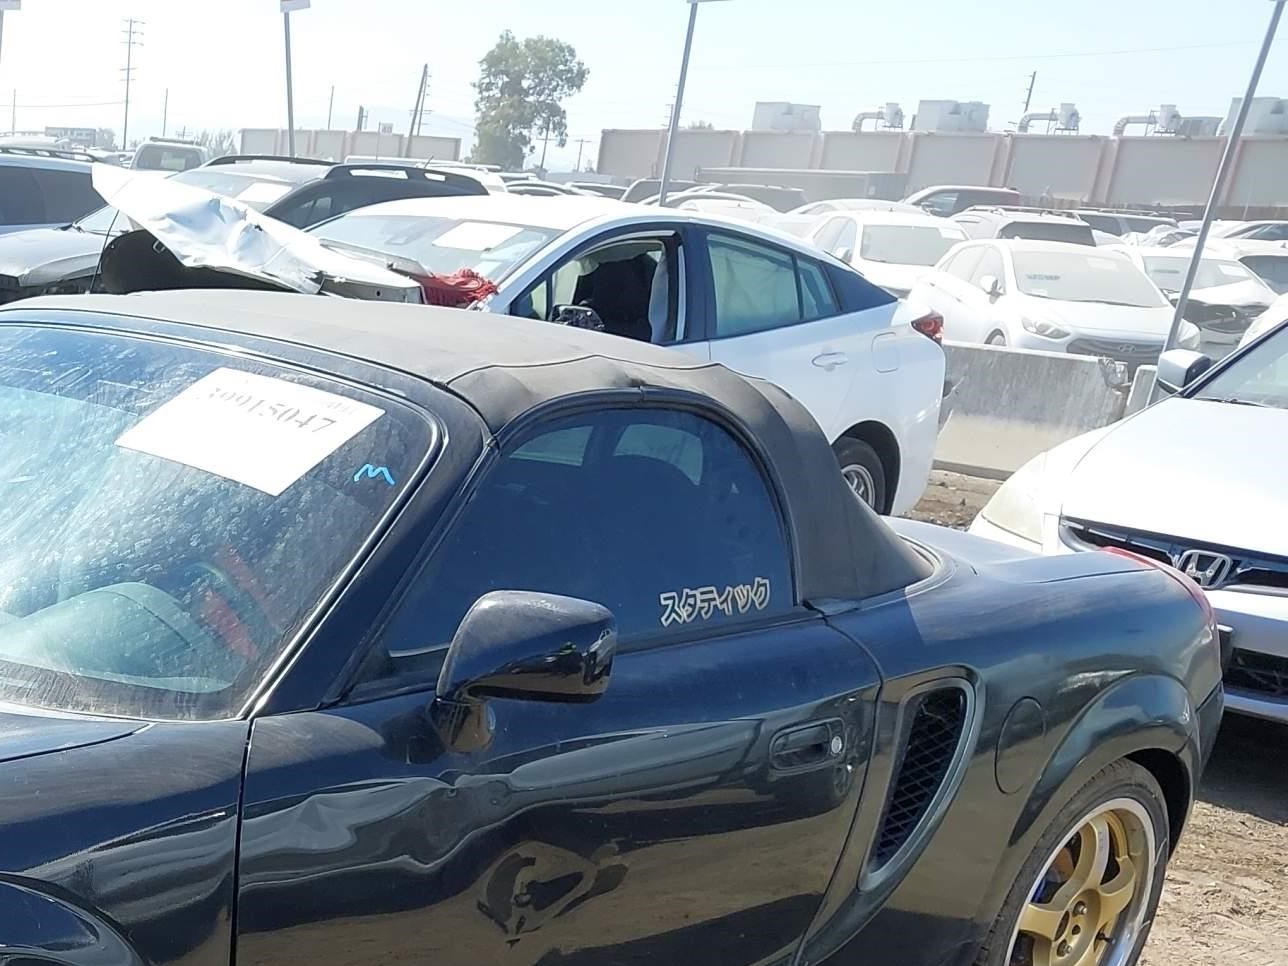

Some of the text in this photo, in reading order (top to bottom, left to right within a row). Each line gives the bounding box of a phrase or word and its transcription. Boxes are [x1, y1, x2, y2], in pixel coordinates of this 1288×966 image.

[659, 576, 771, 627] スタティック
